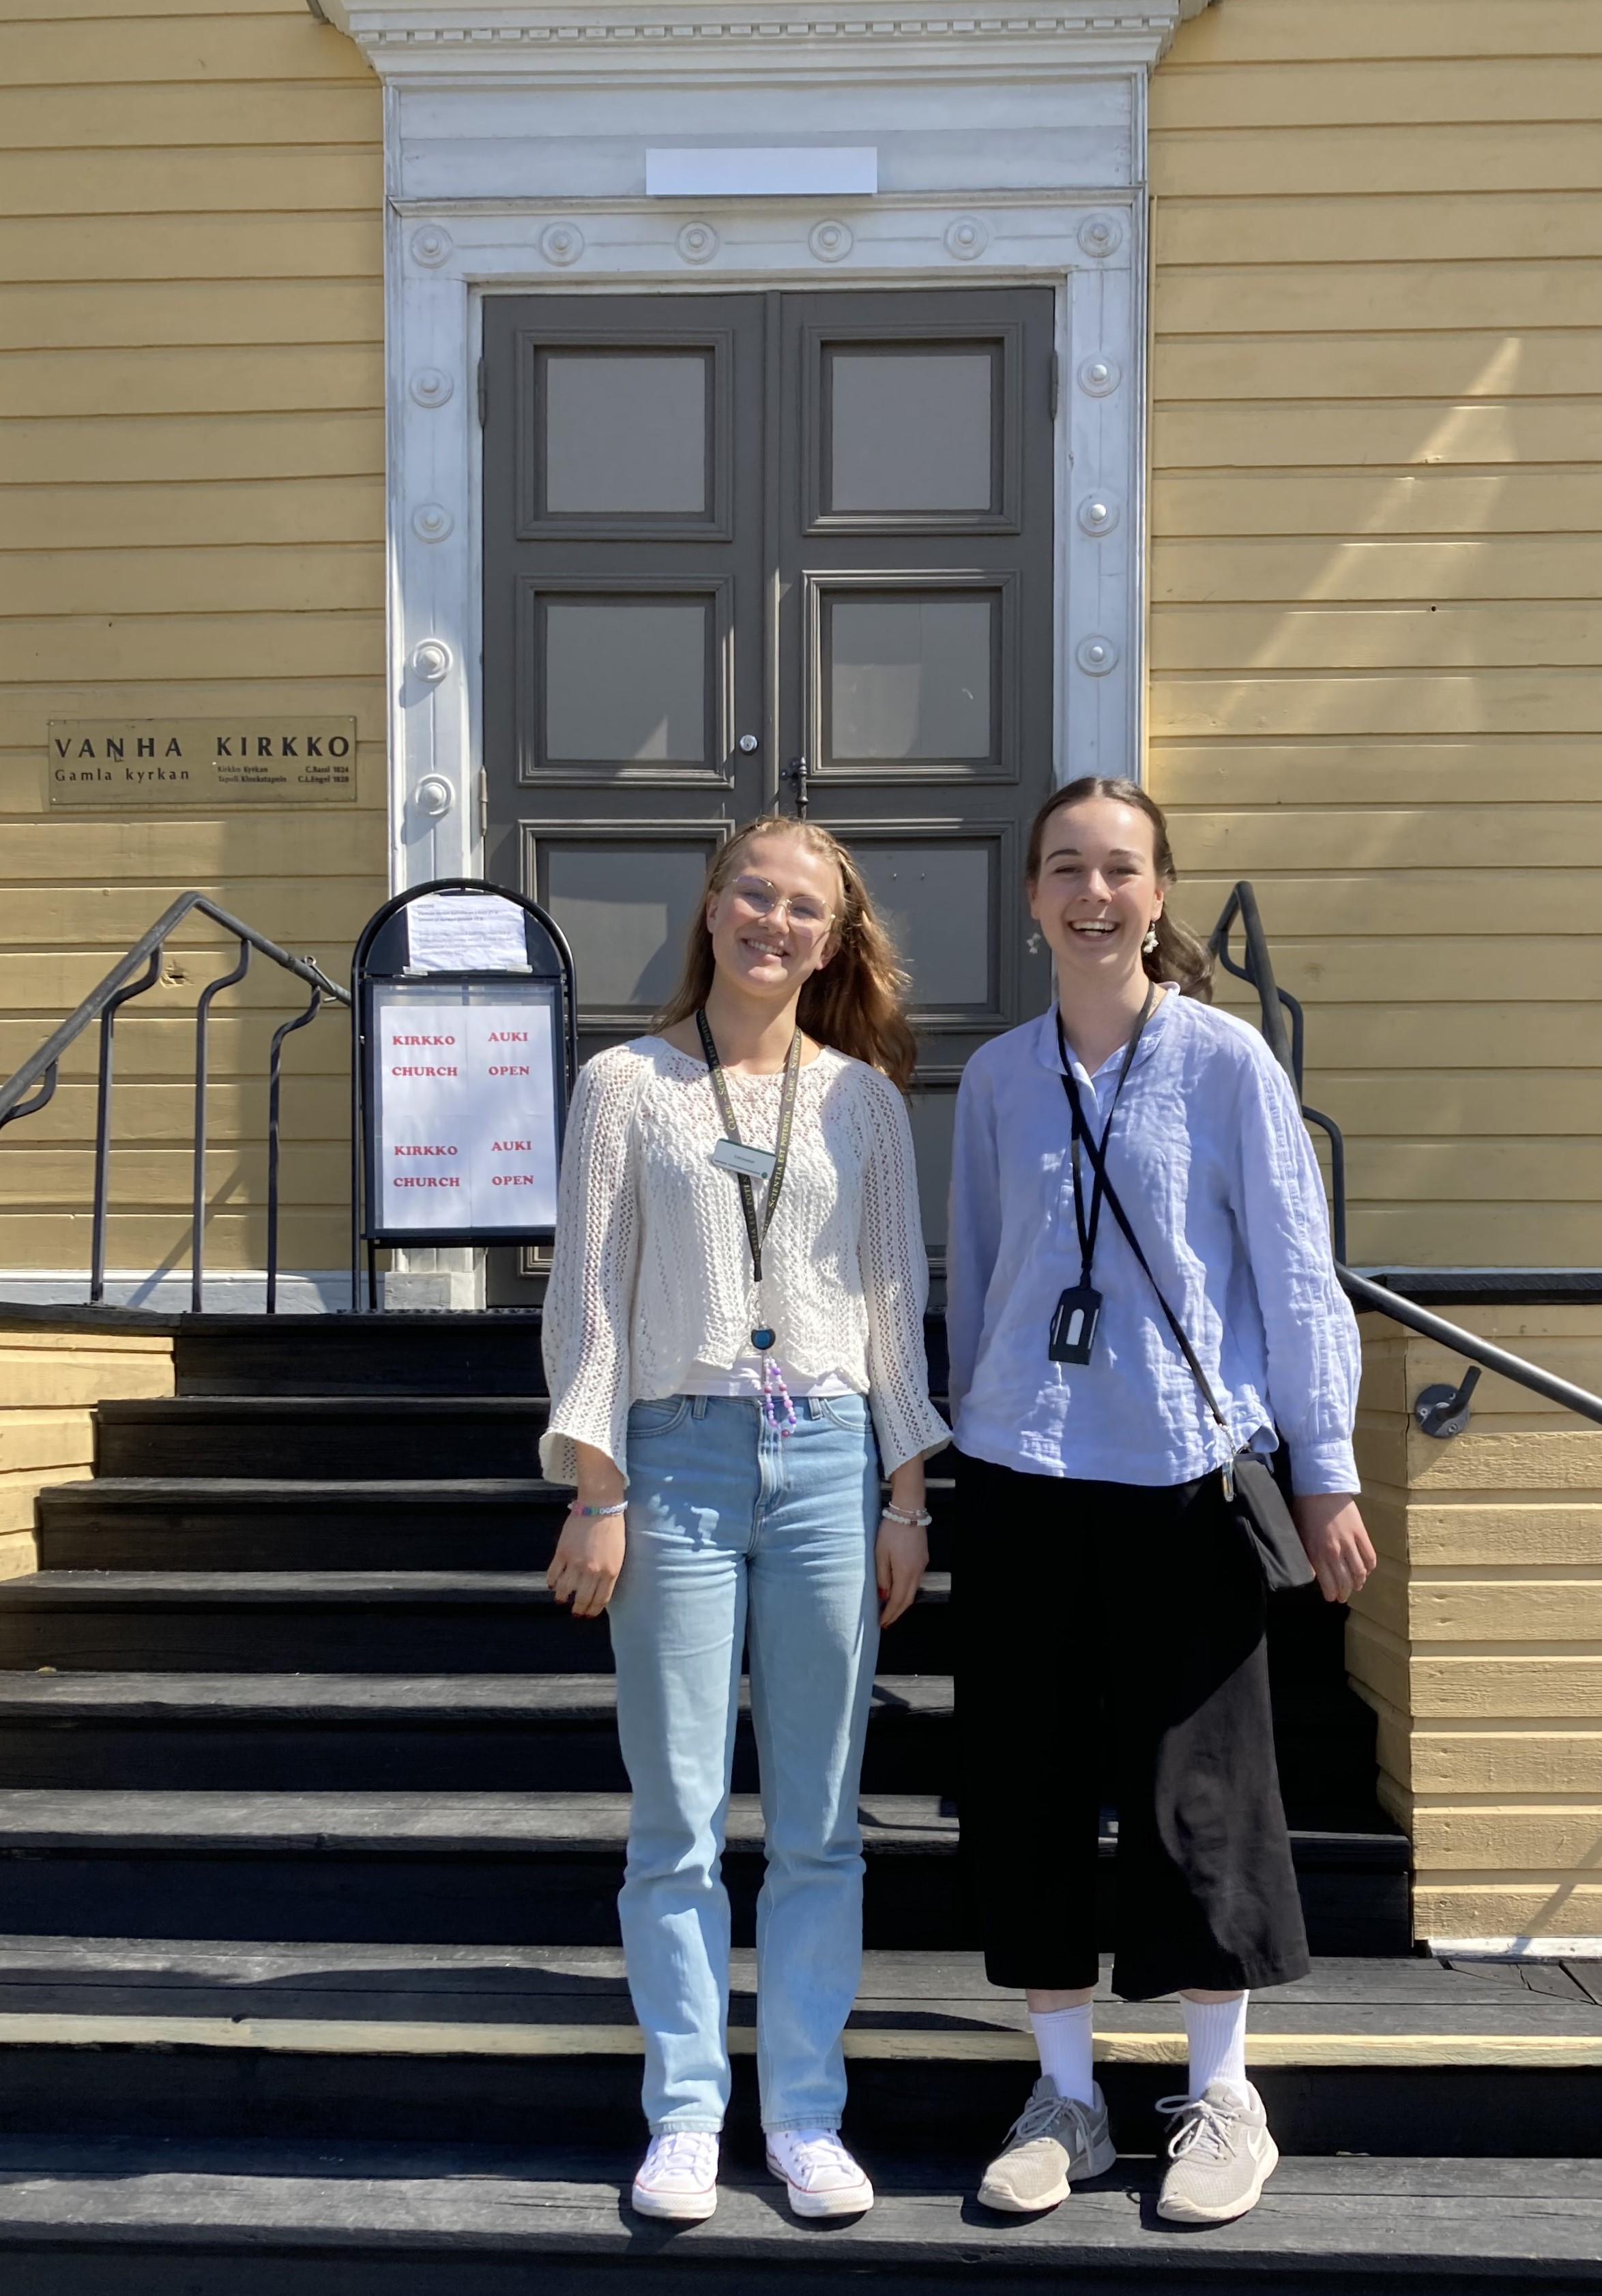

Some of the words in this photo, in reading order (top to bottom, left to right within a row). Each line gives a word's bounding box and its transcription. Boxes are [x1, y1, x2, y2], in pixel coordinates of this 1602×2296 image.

[55, 737, 182, 759] VANHA
[216, 736, 349, 756] KIRKKO
[55, 769, 113, 782] Gamla
[126, 768, 190, 783] kyrkan
[392, 1035, 455, 1045] KIRKKO
[488, 1032, 528, 1042] AUKI
[392, 1066, 458, 1076] CHURCH
[489, 1065, 529, 1076] OPEN
[781, 1110, 791, 1146] POTENTIA
[394, 1145, 458, 1156] KIRKKO
[491, 1140, 531, 1151] AUKI
[778, 1150, 786, 1163] EST
[393, 1177, 460, 1187] CHURCH
[492, 1175, 534, 1186] OPEN
